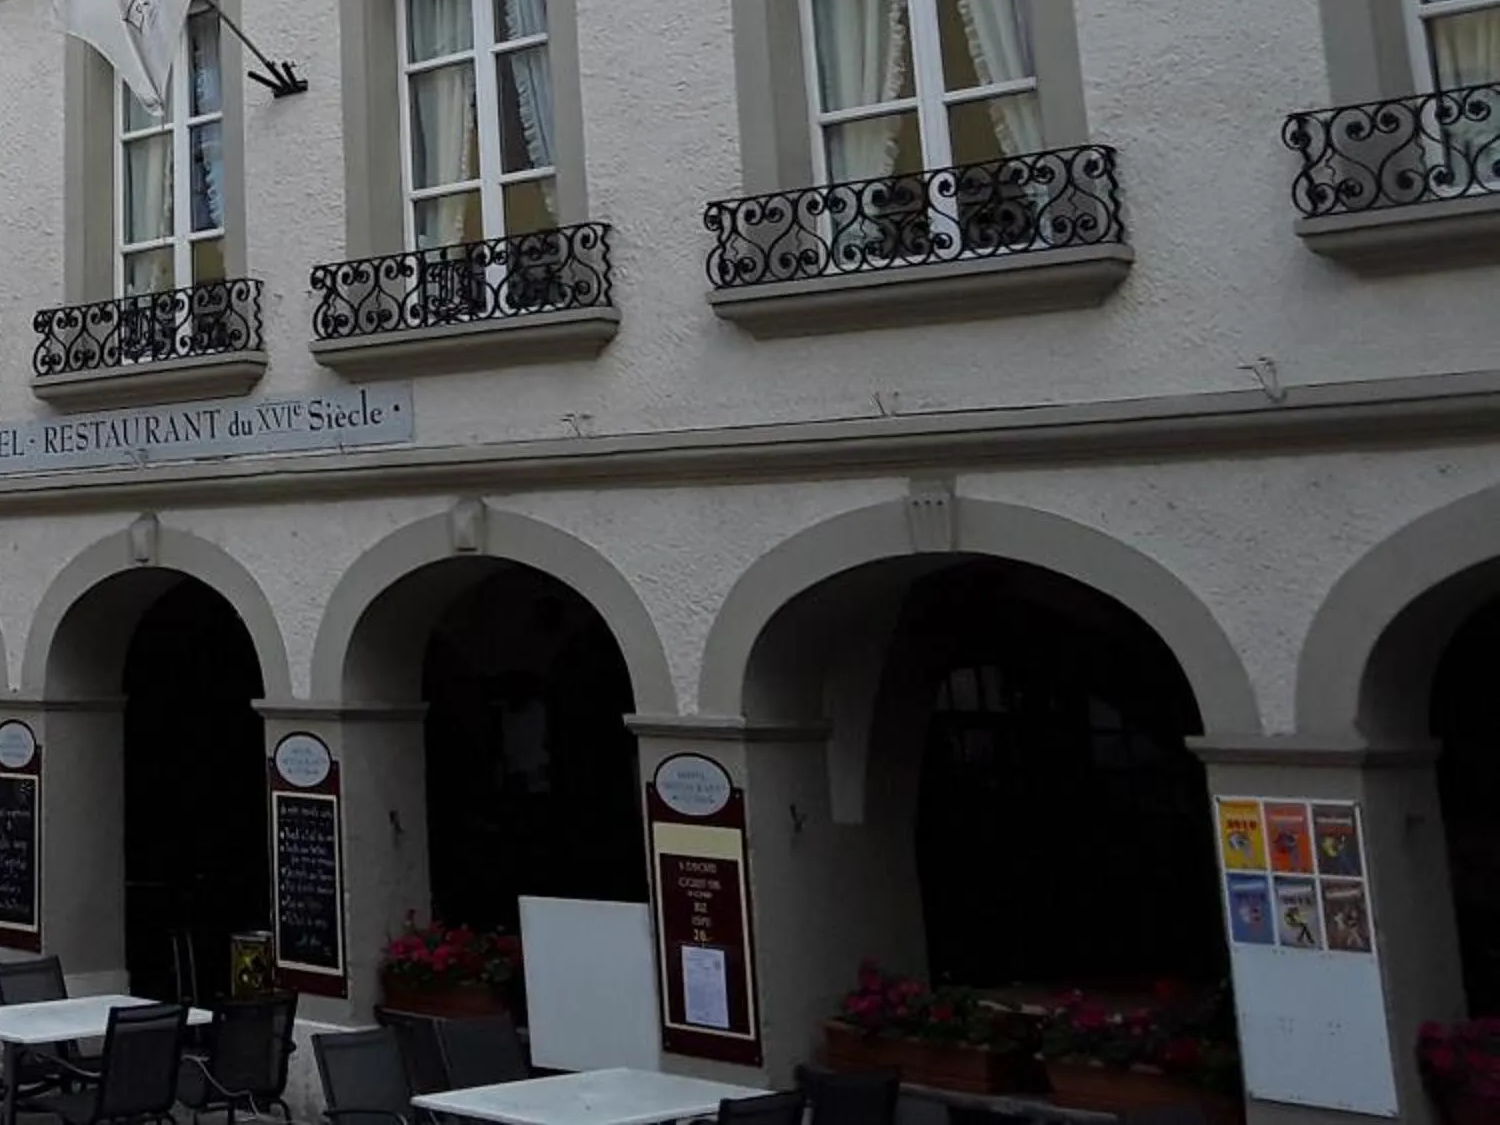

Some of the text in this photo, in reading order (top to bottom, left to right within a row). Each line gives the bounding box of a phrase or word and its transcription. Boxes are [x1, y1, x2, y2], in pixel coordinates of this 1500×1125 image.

[43, 408, 221, 455] RESTAURANT
[228, 410, 253, 437] du
[308, 389, 383, 431] Siècle
